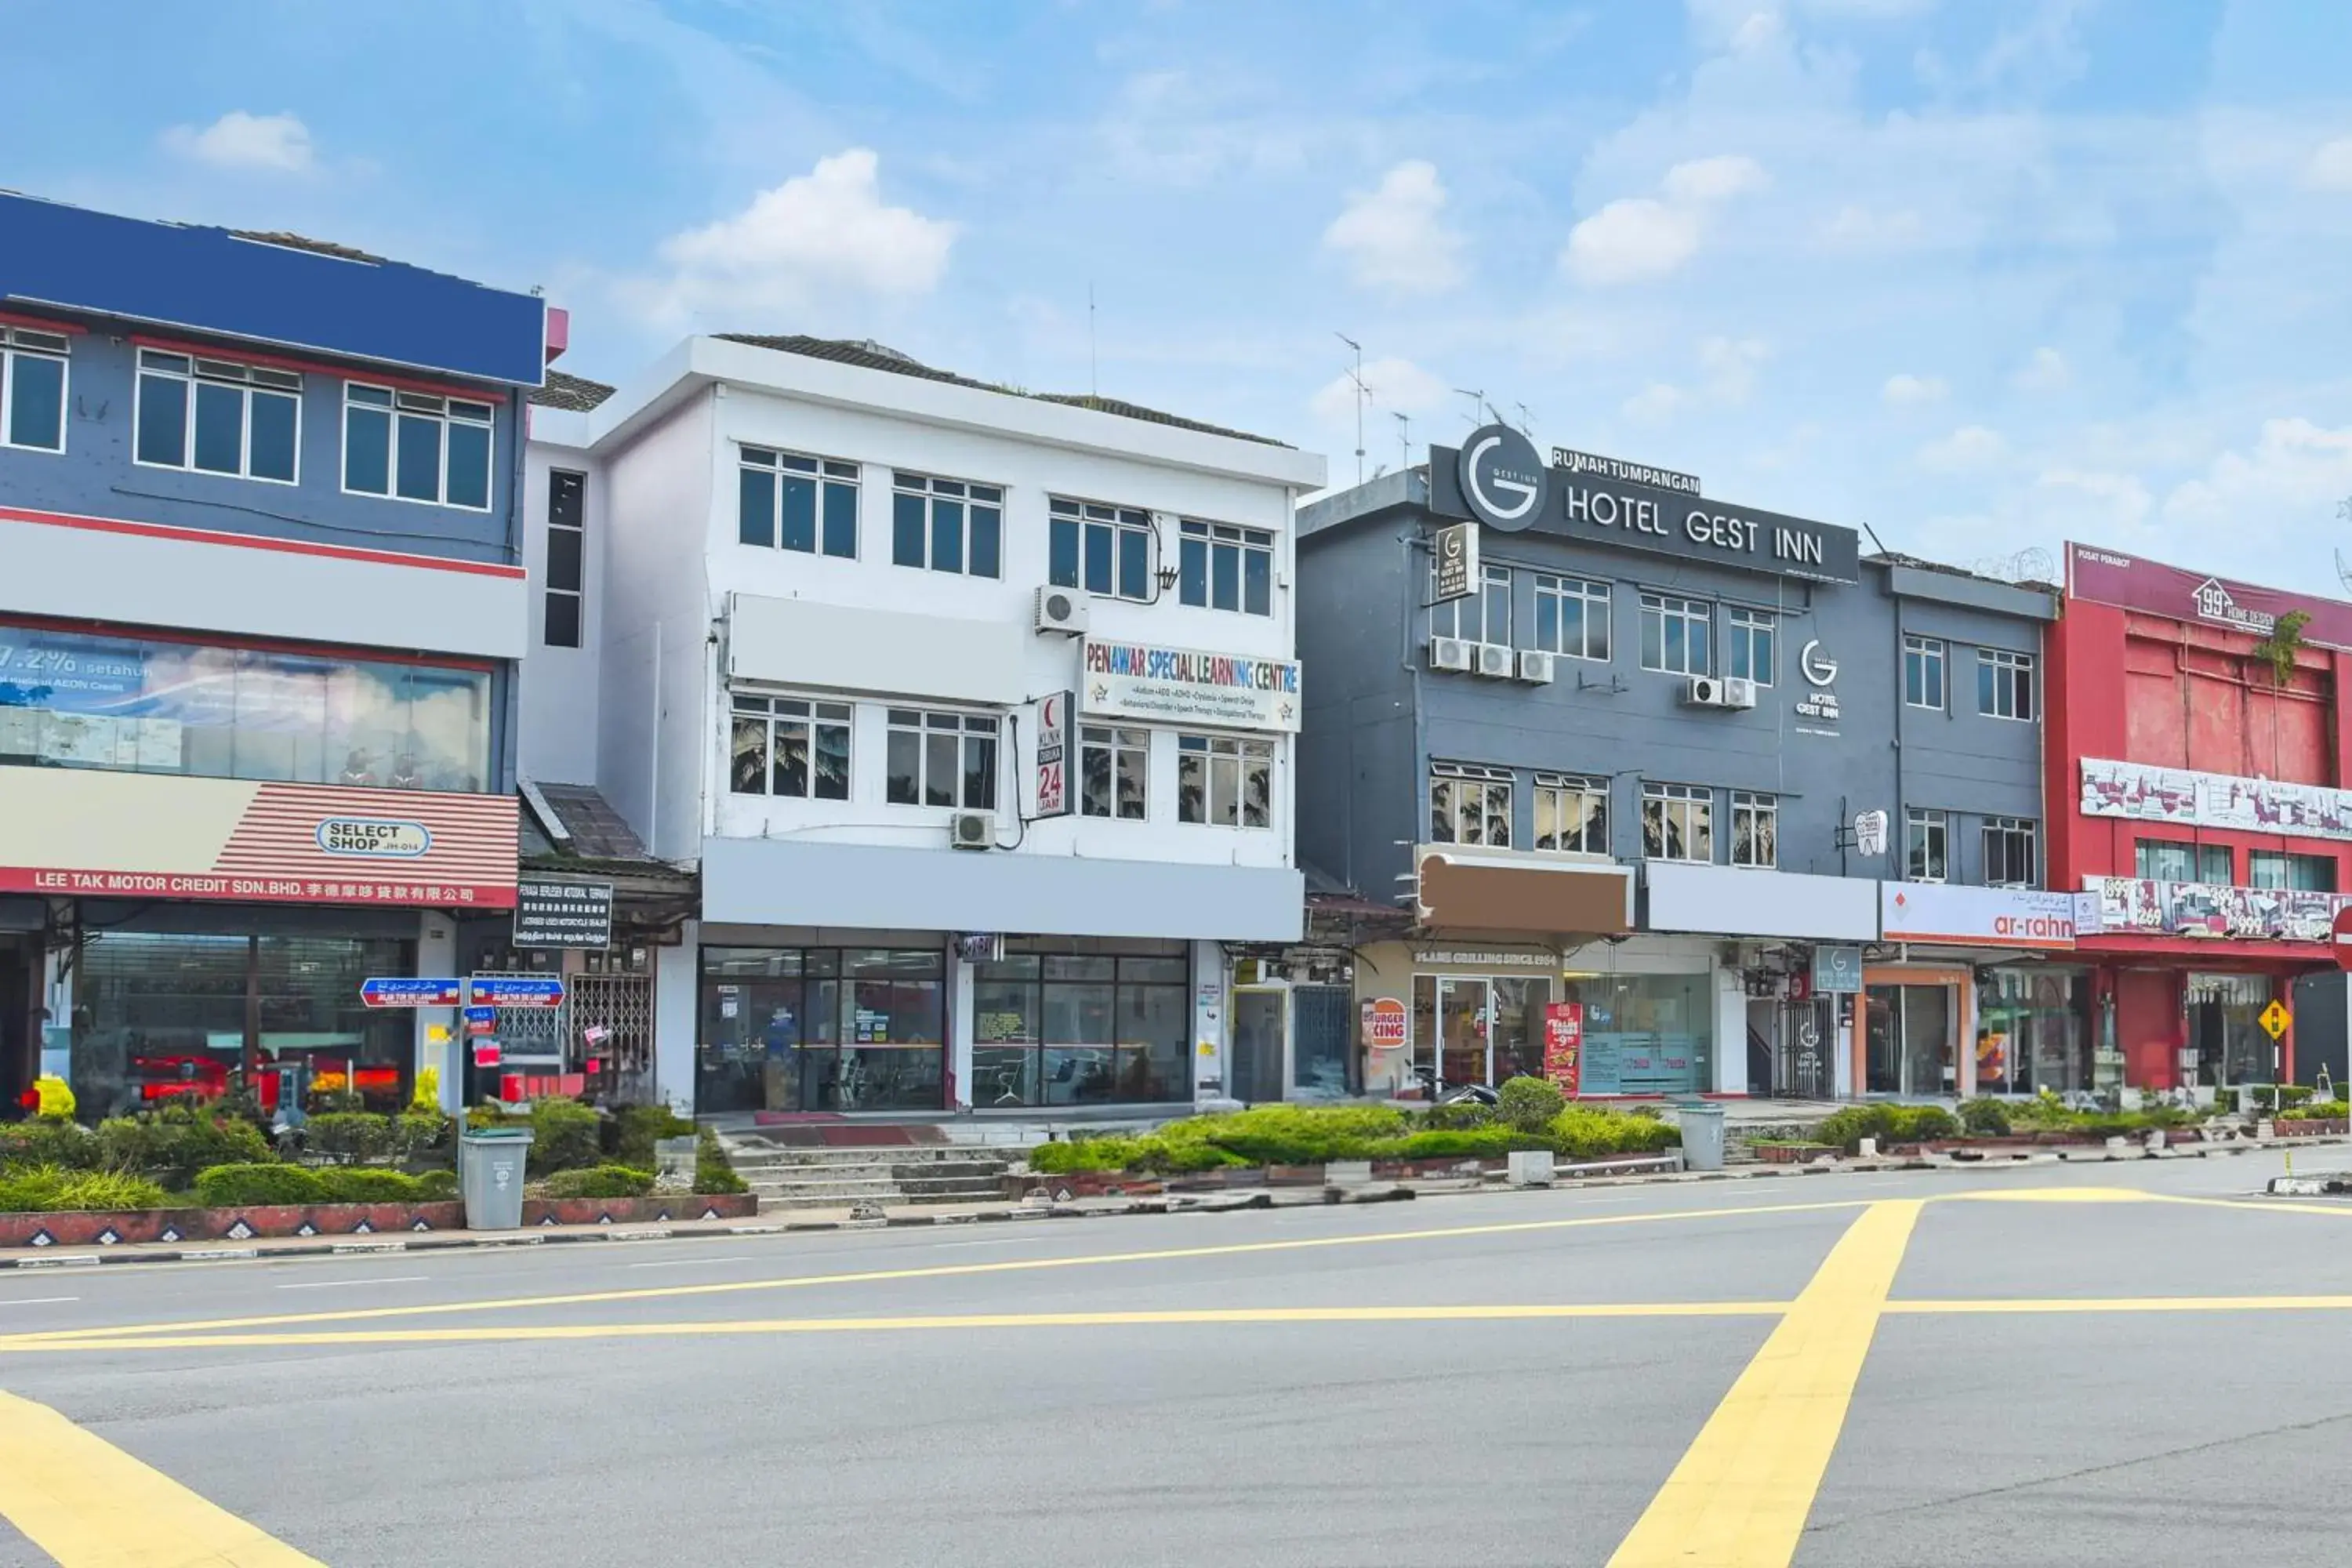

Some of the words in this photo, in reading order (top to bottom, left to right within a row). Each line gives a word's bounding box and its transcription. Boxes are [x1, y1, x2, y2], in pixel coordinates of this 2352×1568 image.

[1552, 449, 1607, 472] RUMAH
[1610, 461, 1700, 493] TUMPANGAN
[1568, 486, 1668, 536] HOTEL
[1686, 510, 1759, 551] GEST
[1775, 527, 1821, 564] INN
[2204, 588, 2223, 615] 99
[1087, 643, 1145, 677] PENAWAR
[1148, 649, 1195, 683] SPECIAL
[1197, 655, 1254, 688] LEARNING
[1255, 662, 1298, 694] CENTRE
[53, 679, 88, 690] AEON
[90, 681, 124, 692] Credit
[1809, 693, 1838, 706] HOTEL
[1040, 764, 1061, 798] 24
[329, 823, 400, 838] SELECT
[328, 837, 379, 851] SHOP
[35, 873, 67, 887] LEE
[72, 873, 103, 887] TAK
[107, 875, 166, 890] MOTOR
[171, 877, 228, 892] CREDIT
[232, 880, 304, 896] SDN.BHD.
[1994, 913, 2073, 938] ar-rahn
[1454, 953, 1502, 964] GRILLING
[1504, 953, 1534, 965] SINCE
[1369, 1013, 1404, 1023] URGER
